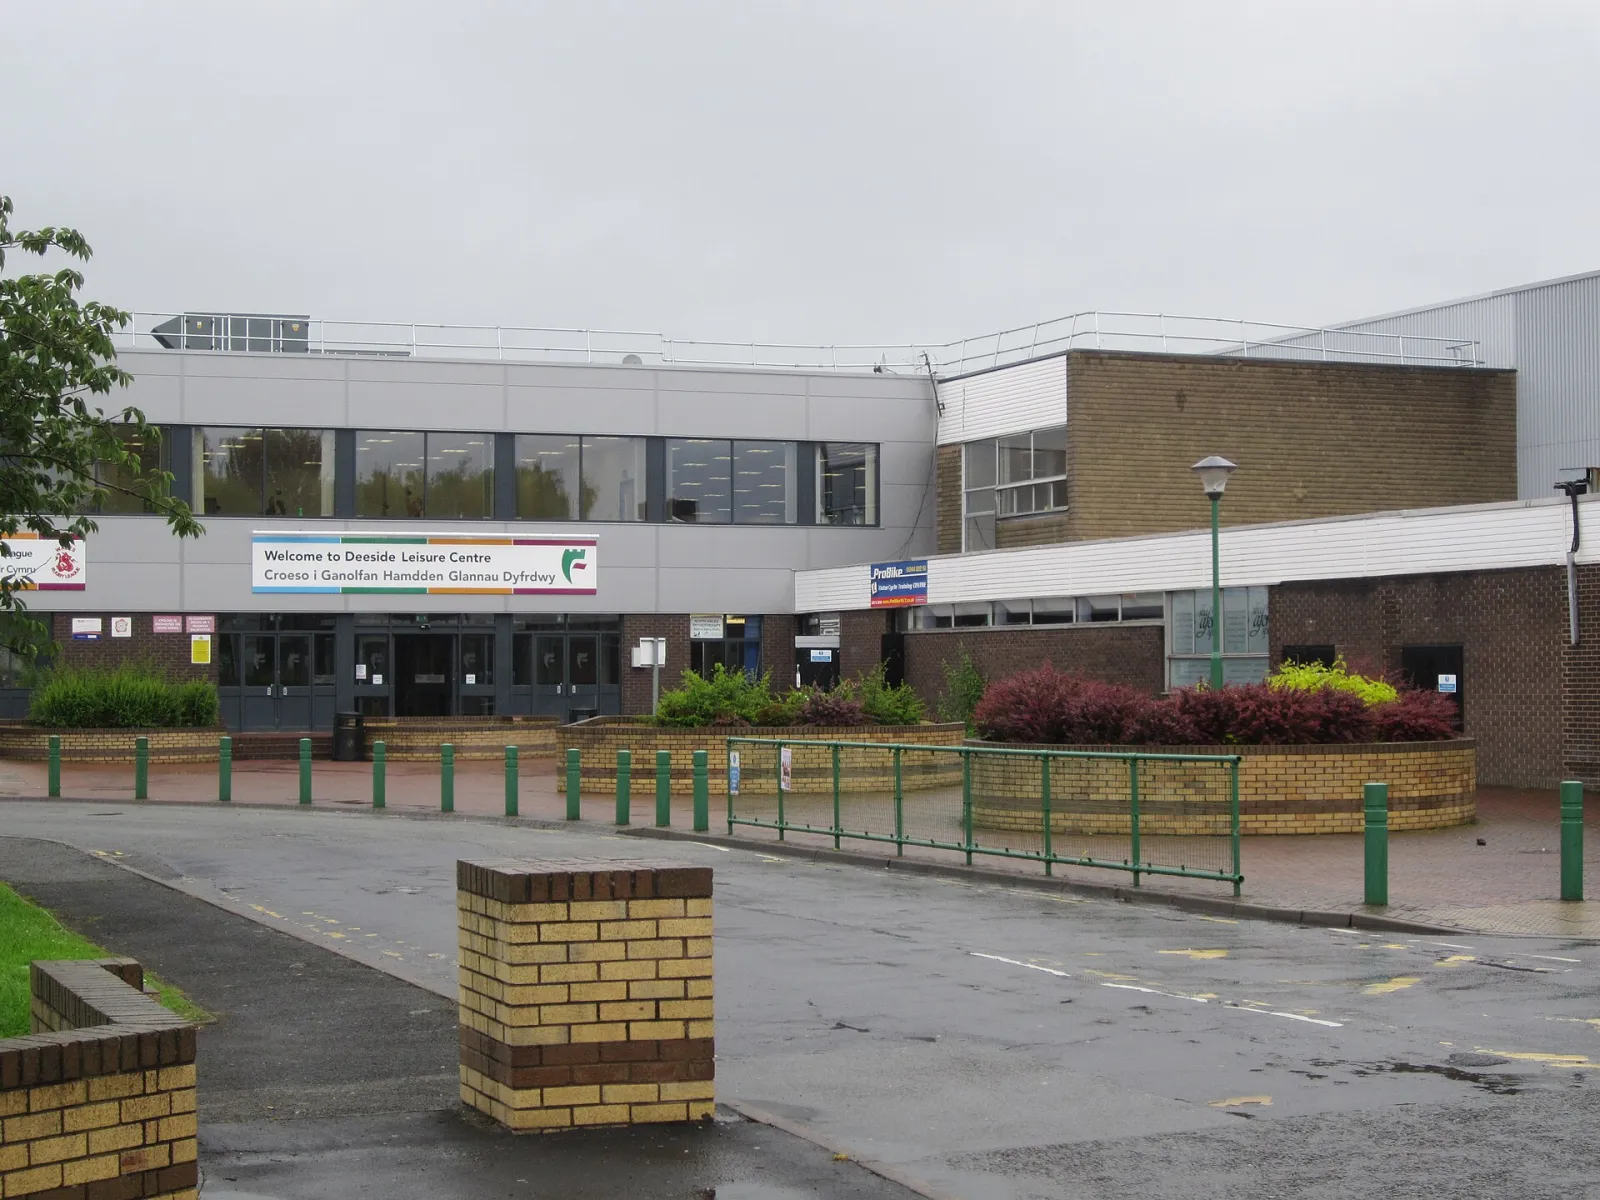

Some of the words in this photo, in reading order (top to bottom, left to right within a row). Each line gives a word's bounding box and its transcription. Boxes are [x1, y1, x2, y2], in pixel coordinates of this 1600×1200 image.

[264, 550, 323, 562] Welcome
[327, 552, 341, 562] to
[345, 551, 396, 562] Deeside
[401, 552, 446, 563] Leisure
[449, 552, 492, 563] Centre
[6, 564, 36, 575] Cymru
[873, 566, 903, 579] ProBike
[264, 569, 310, 581] Croeso
[313, 570, 317, 580] i
[321, 569, 378, 581] Ganolfan
[383, 570, 444, 581] Hamdden
[448, 570, 499, 582] Glannau
[503, 571, 556, 584] Dyfrdwy
